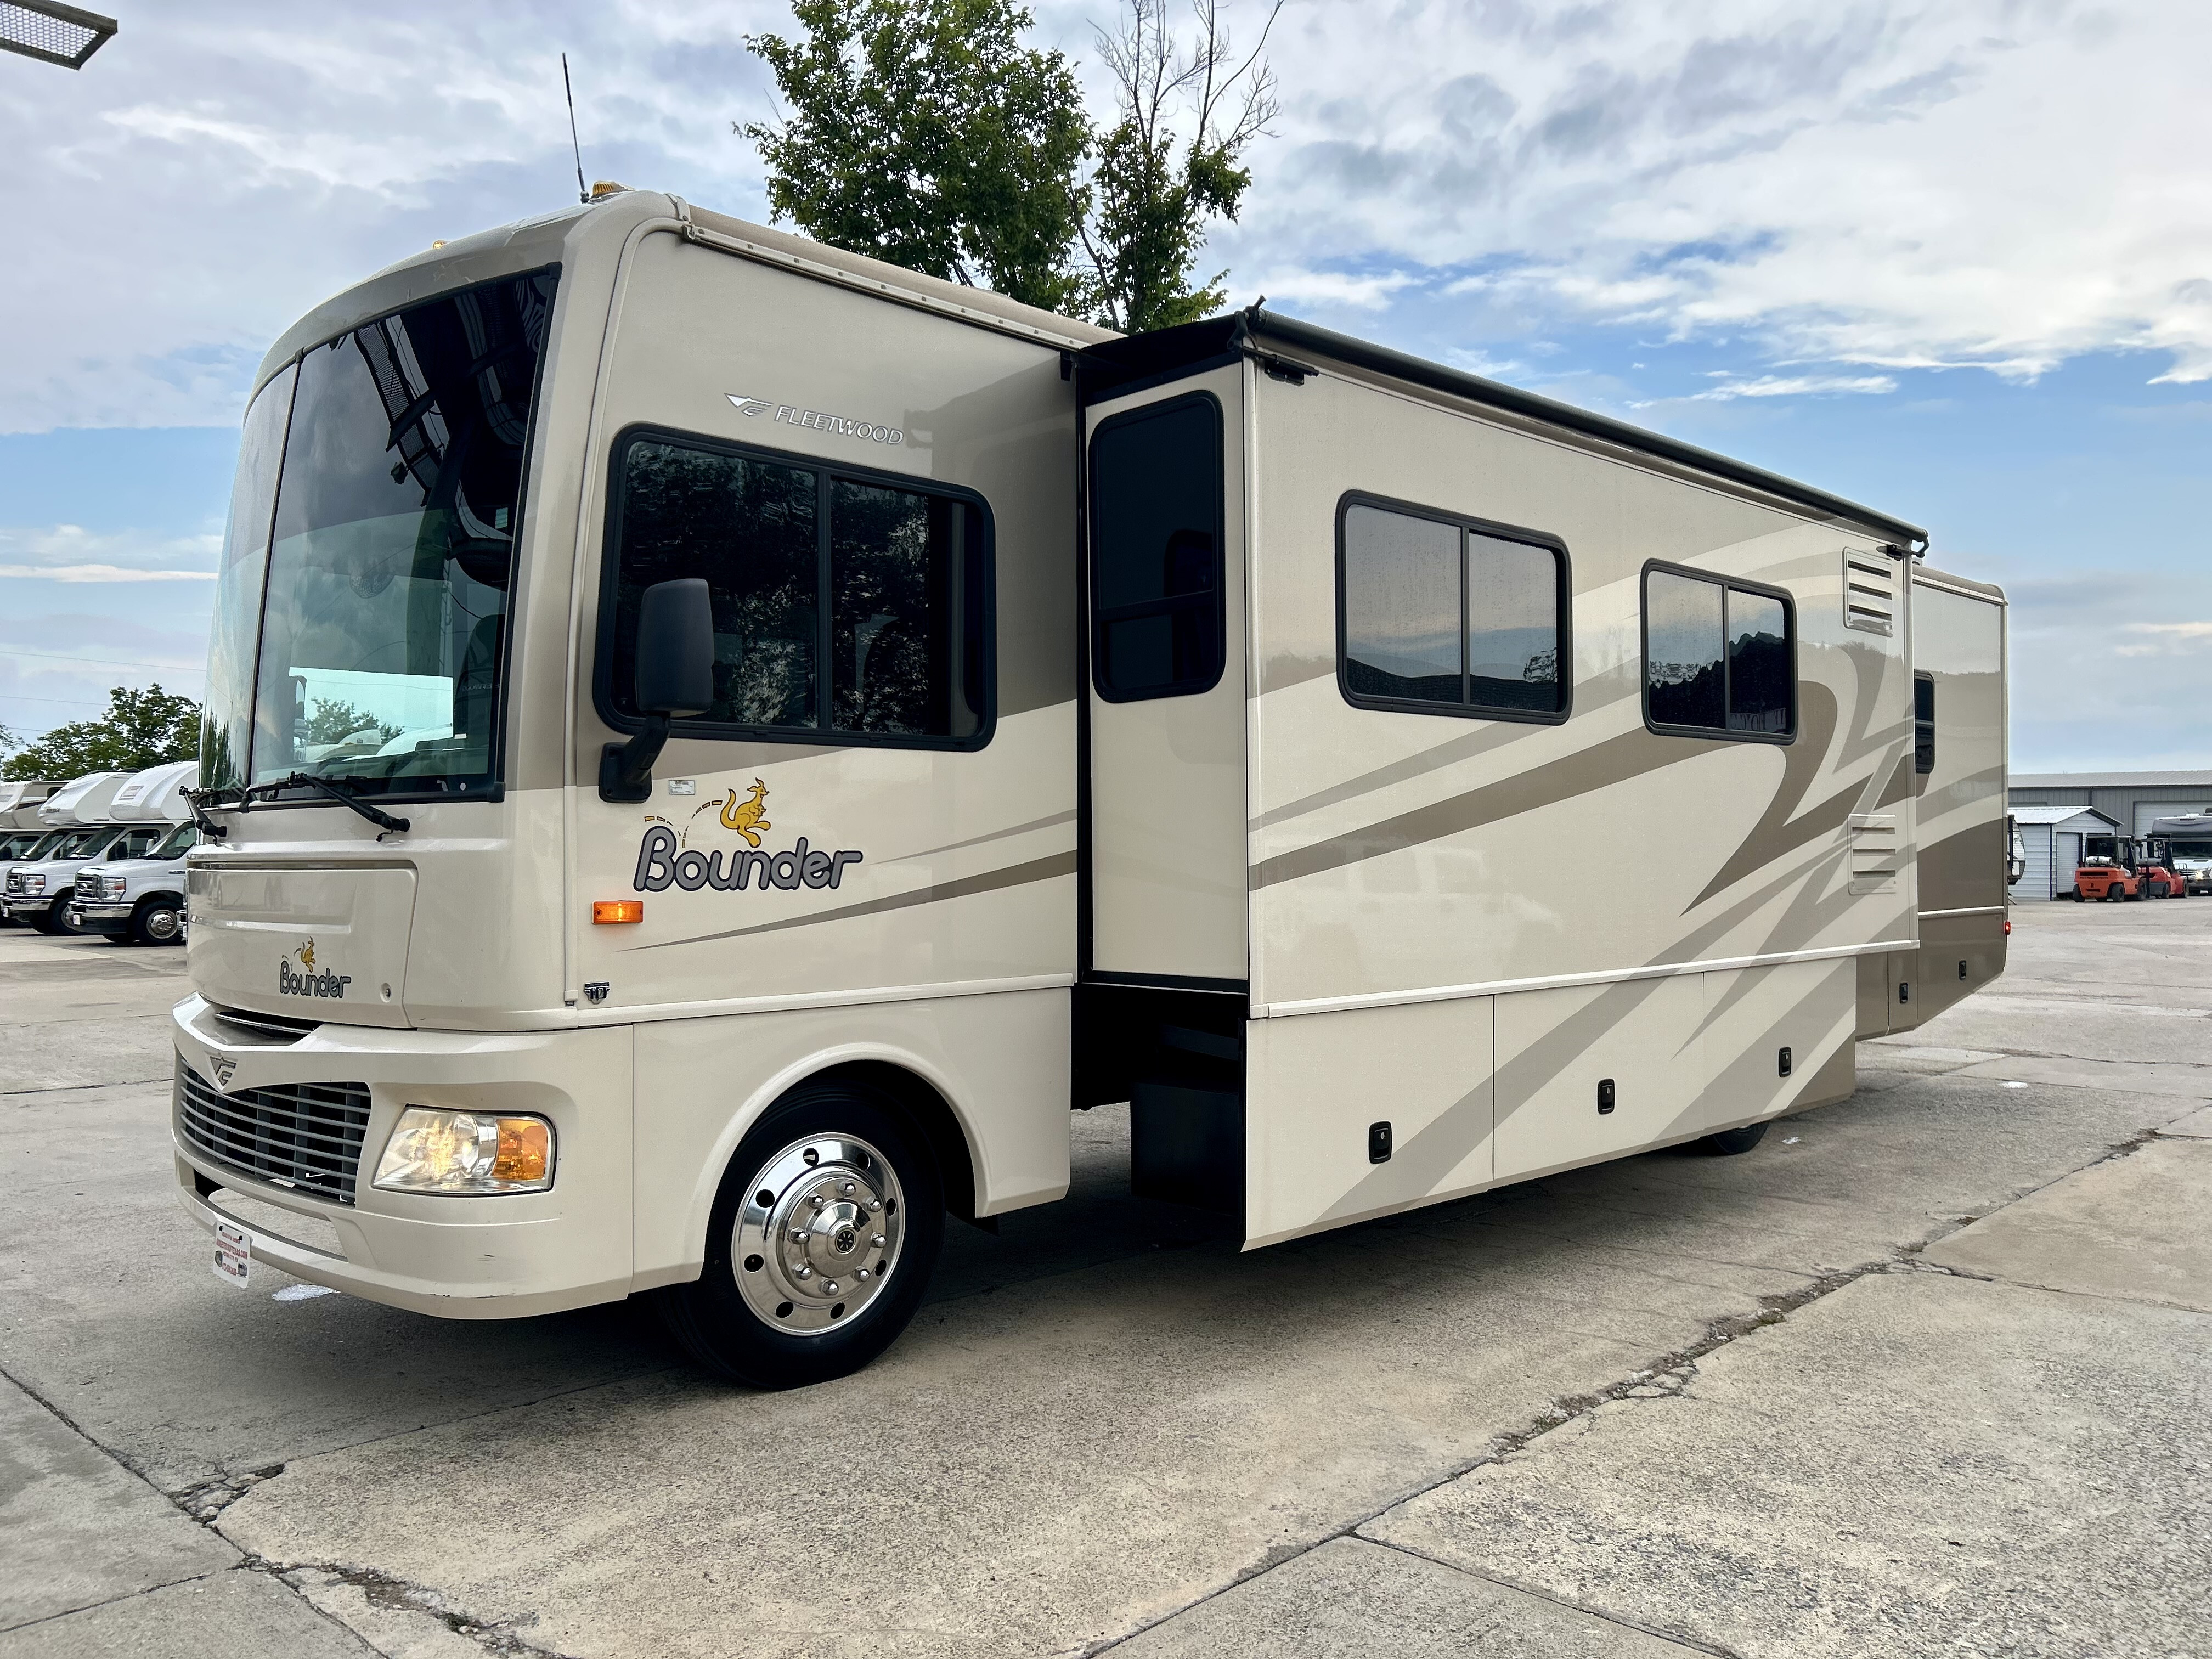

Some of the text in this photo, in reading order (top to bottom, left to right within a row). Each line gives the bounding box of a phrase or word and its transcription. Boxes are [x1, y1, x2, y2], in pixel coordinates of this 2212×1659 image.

[774, 404, 904, 445] FLEETWOOD
[634, 826, 863, 892] Bounder
[280, 960, 351, 998] Bounder
